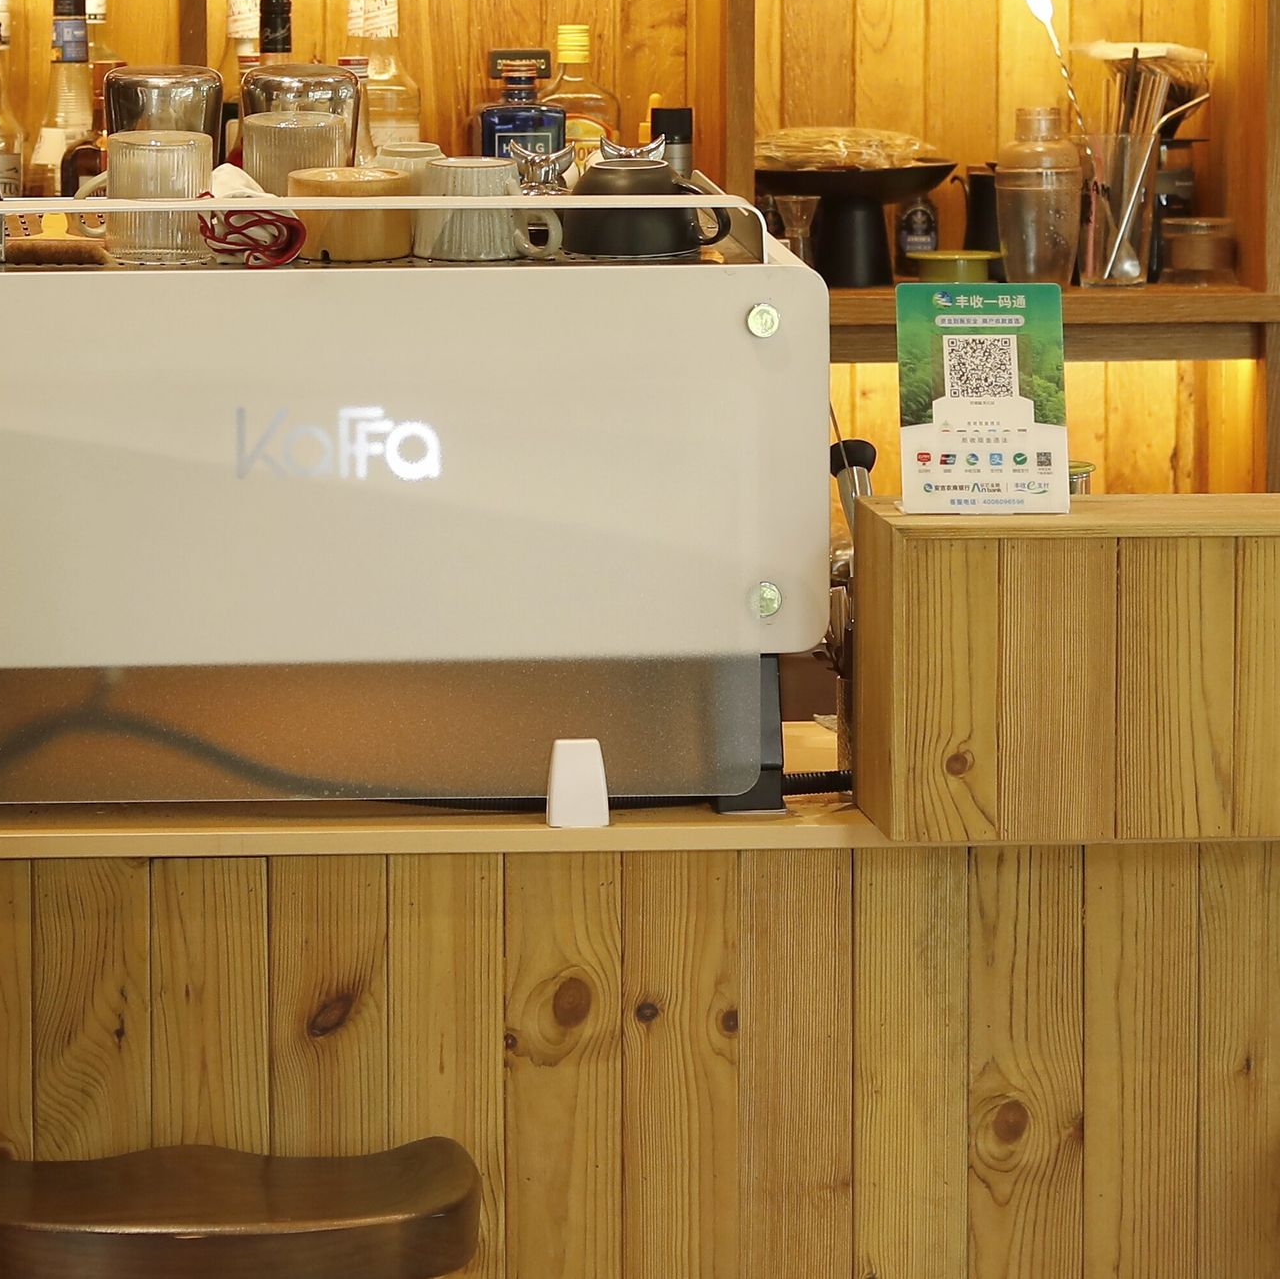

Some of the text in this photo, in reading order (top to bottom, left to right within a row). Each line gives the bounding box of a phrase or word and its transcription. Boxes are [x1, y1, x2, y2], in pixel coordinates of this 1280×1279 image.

[956, 295, 1026, 308] 丰收一码通
